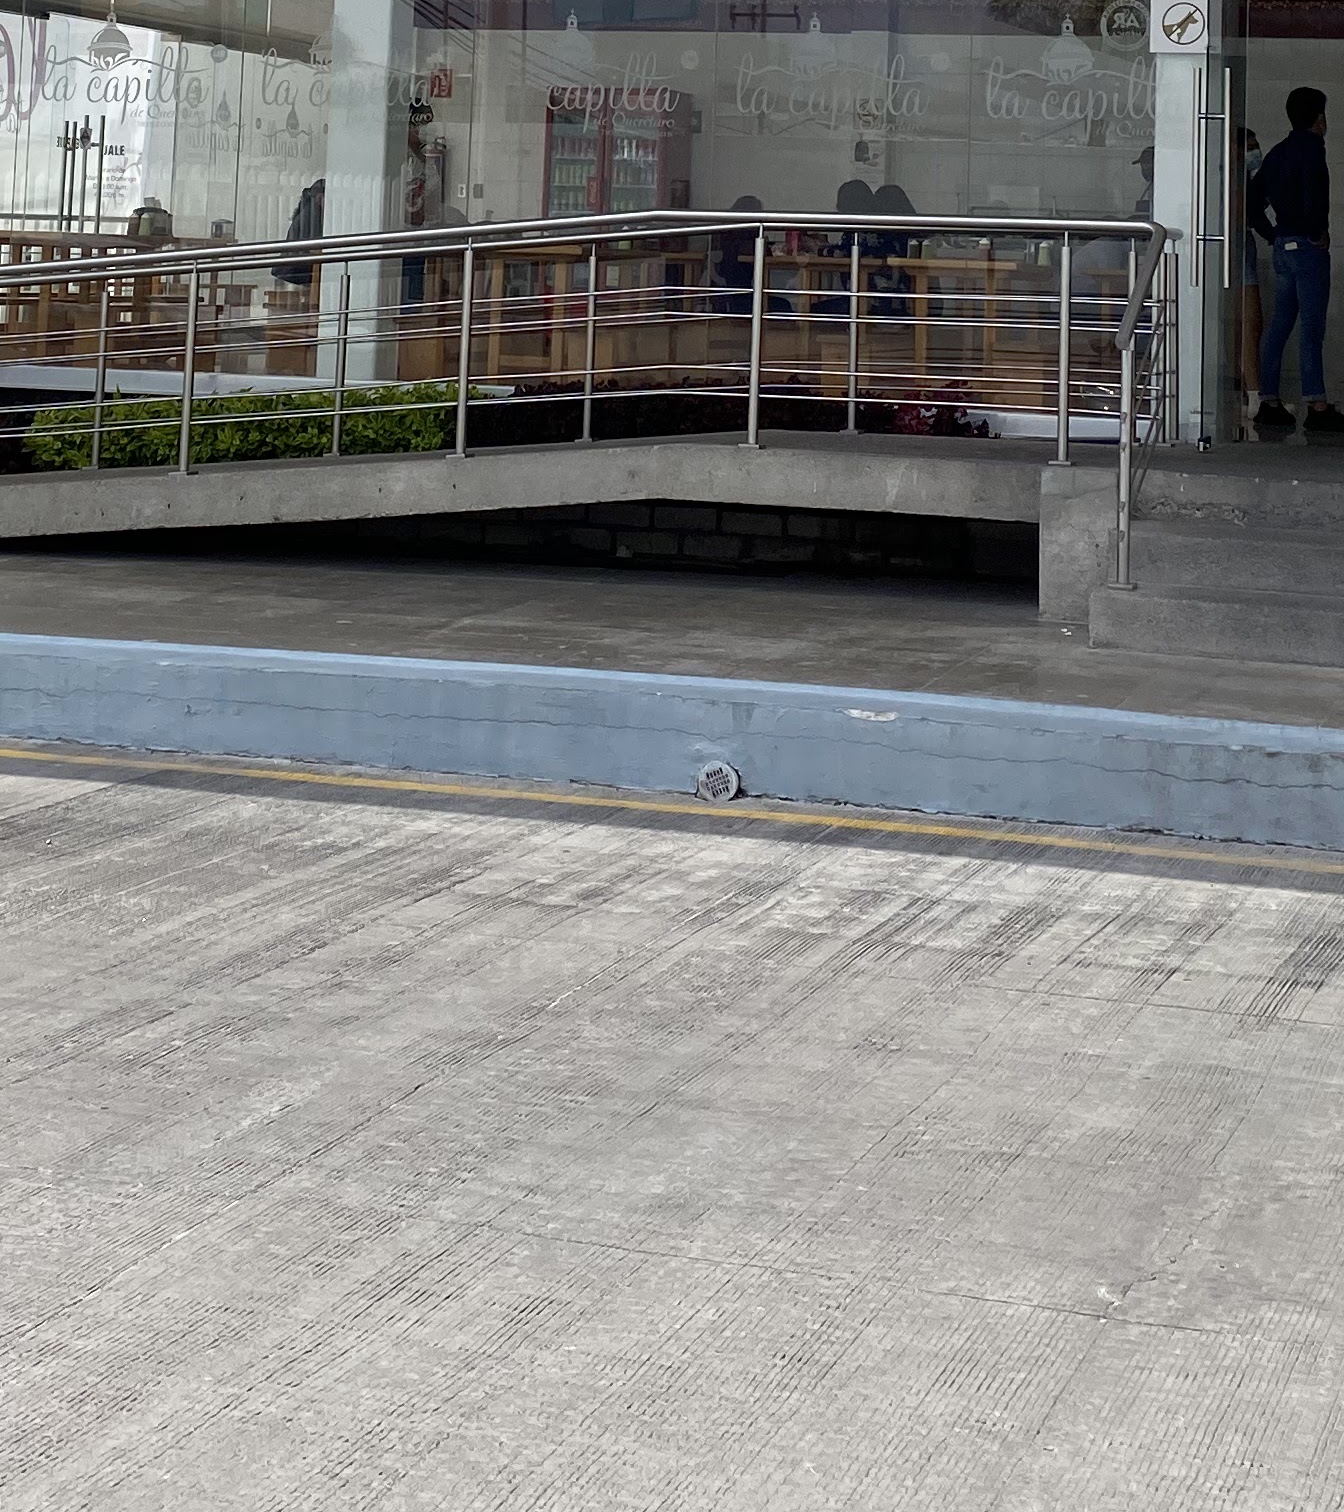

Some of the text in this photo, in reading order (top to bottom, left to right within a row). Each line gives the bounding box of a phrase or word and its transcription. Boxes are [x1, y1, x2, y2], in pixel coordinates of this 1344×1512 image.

[40, 45, 210, 125] la capilla
[261, 48, 299, 106] la
[546, 51, 681, 134] capilla
[736, 52, 777, 115] la
[986, 56, 1156, 146] la capill
